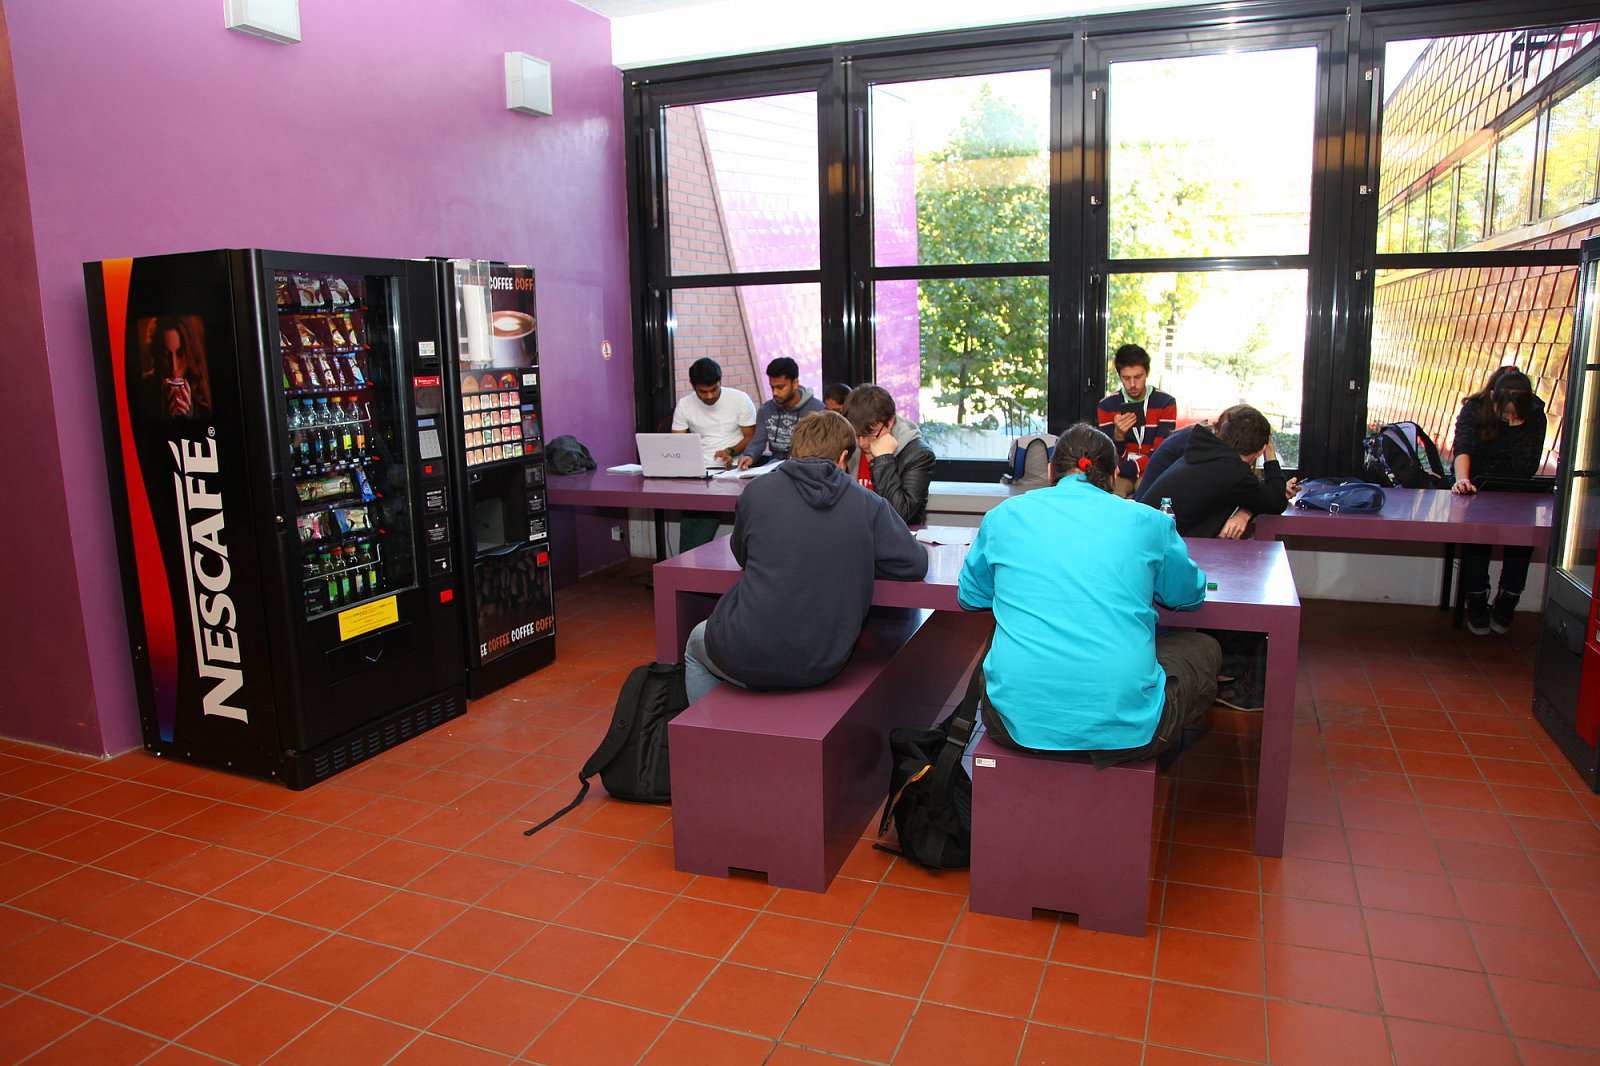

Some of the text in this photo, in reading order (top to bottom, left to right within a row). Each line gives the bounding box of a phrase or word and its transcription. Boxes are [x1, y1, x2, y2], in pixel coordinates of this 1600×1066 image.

[489, 276, 514, 291] COFFEE
[515, 278, 534, 291] COFF
[660, 452, 681, 460] VAIO
[480, 616, 552, 658] EE COFFEE COFFEE COFF
